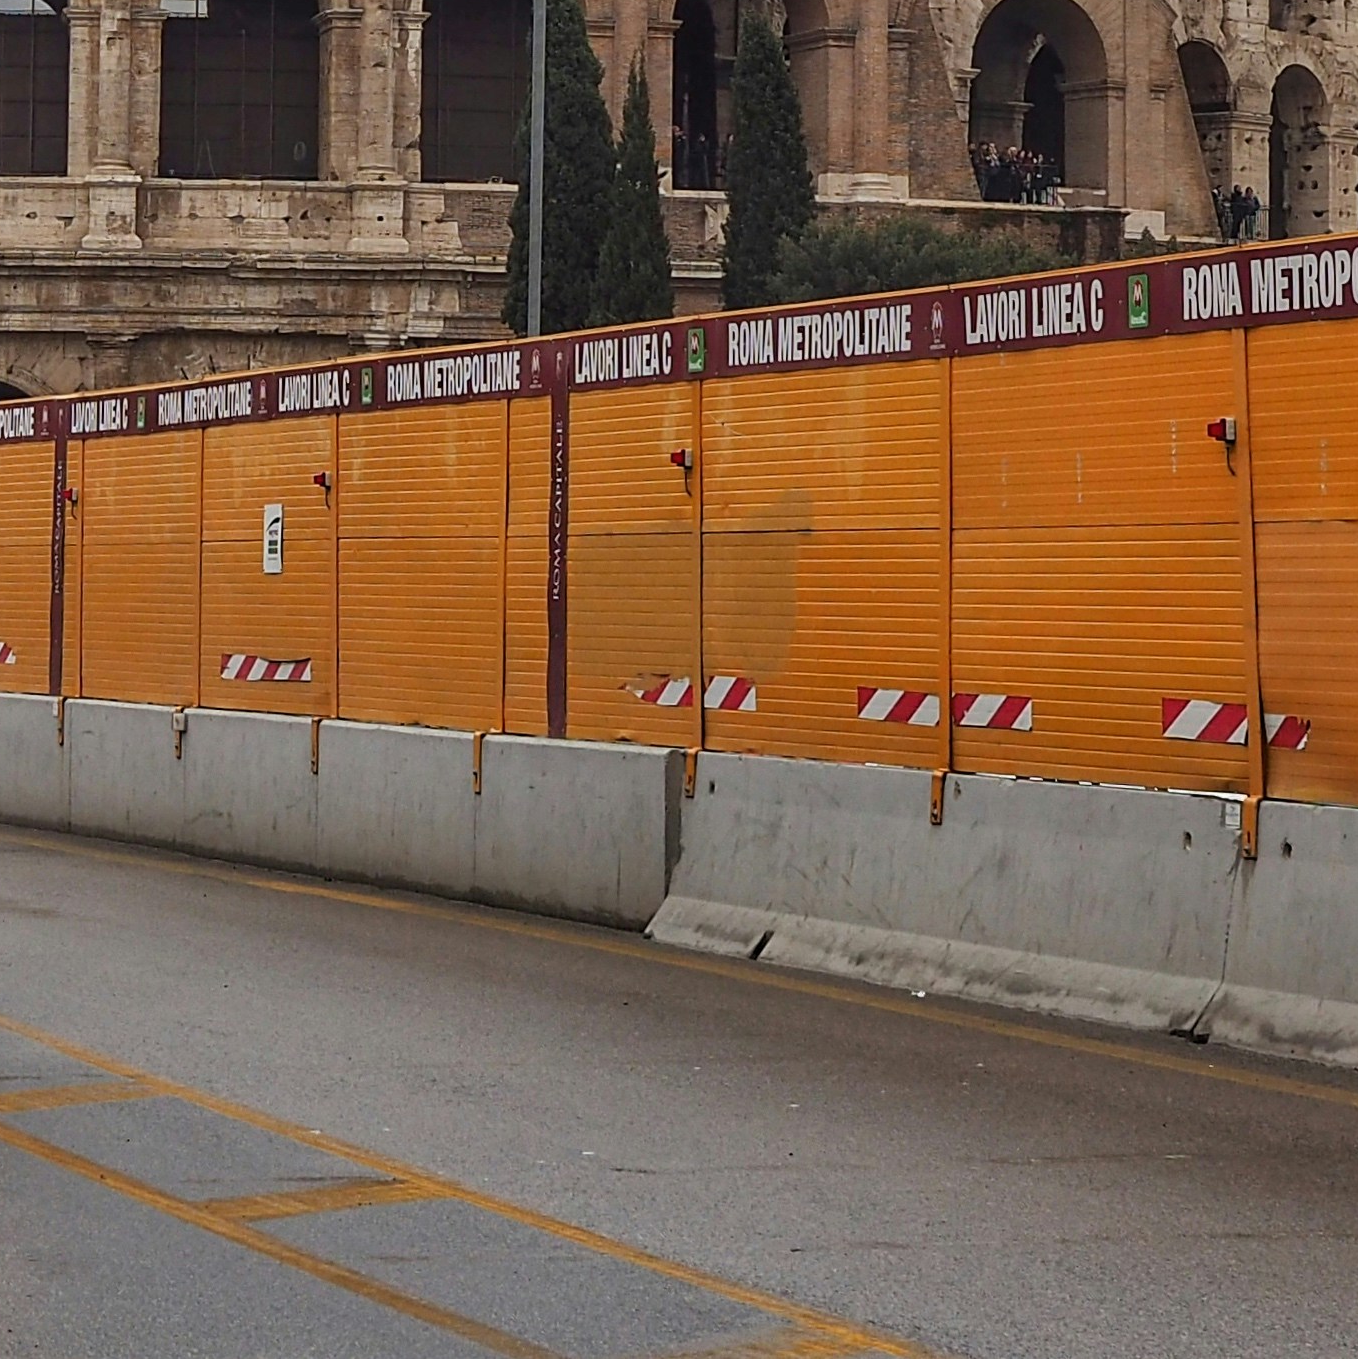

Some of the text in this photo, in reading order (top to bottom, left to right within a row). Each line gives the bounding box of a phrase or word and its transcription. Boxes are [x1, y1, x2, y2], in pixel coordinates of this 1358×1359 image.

[963, 279, 1104, 345] LAVORI LINEA C
[1182, 261, 1243, 321] ROMA
[575, 331, 672, 384] LAVORI LINEA C
[728, 304, 911, 367] ROMA METROPOLITANE
[278, 369, 350, 412] LAVORI LINEA C
[387, 350, 520, 403] ROMA METROPOLITANE
[99, 399, 121, 431] LINEA
[122, 397, 129, 429] C
[158, 381, 252, 426] ROMA METROPOLITANE
